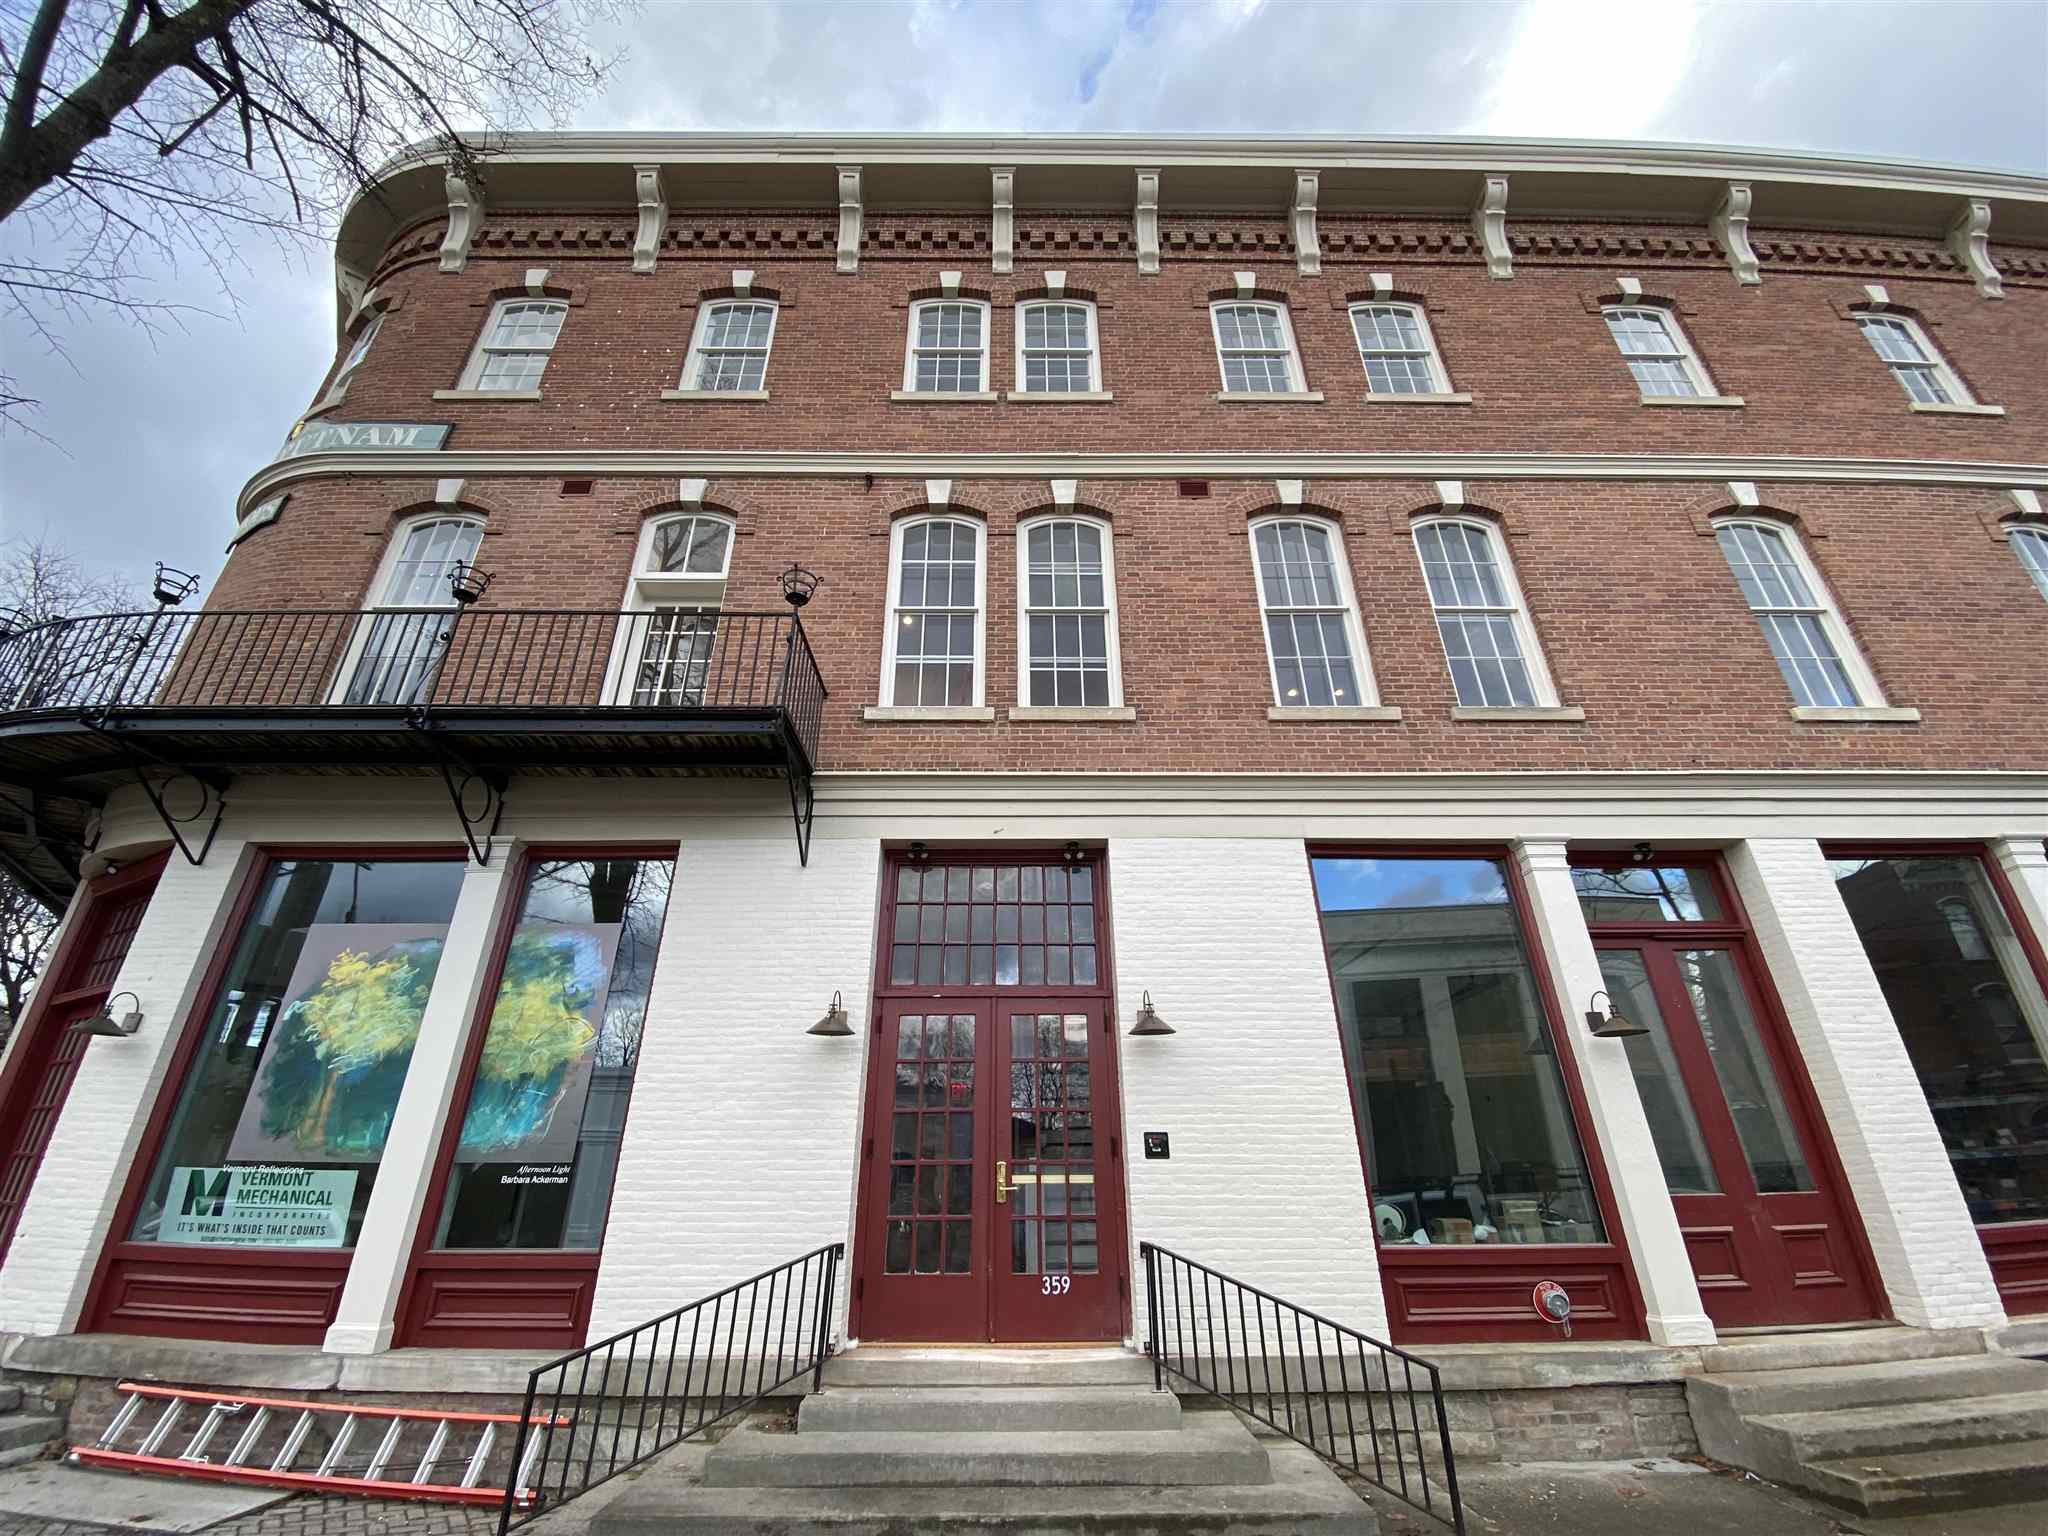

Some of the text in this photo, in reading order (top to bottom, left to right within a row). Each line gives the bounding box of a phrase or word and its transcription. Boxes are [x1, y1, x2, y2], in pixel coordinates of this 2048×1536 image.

[223, 1164, 257, 1174] Vermont
[517, 1165, 571, 1174] Afternoon Light
[241, 1171, 314, 1186] VERMONT
[501, 1175, 568, 1184] Barbara Ackerman
[236, 1189, 333, 1205] MECHANICAL
[177, 1222, 326, 1235] IT'S WHAT'S INSIDE THAT COUNTS
[1042, 1276, 1071, 1295] 359
